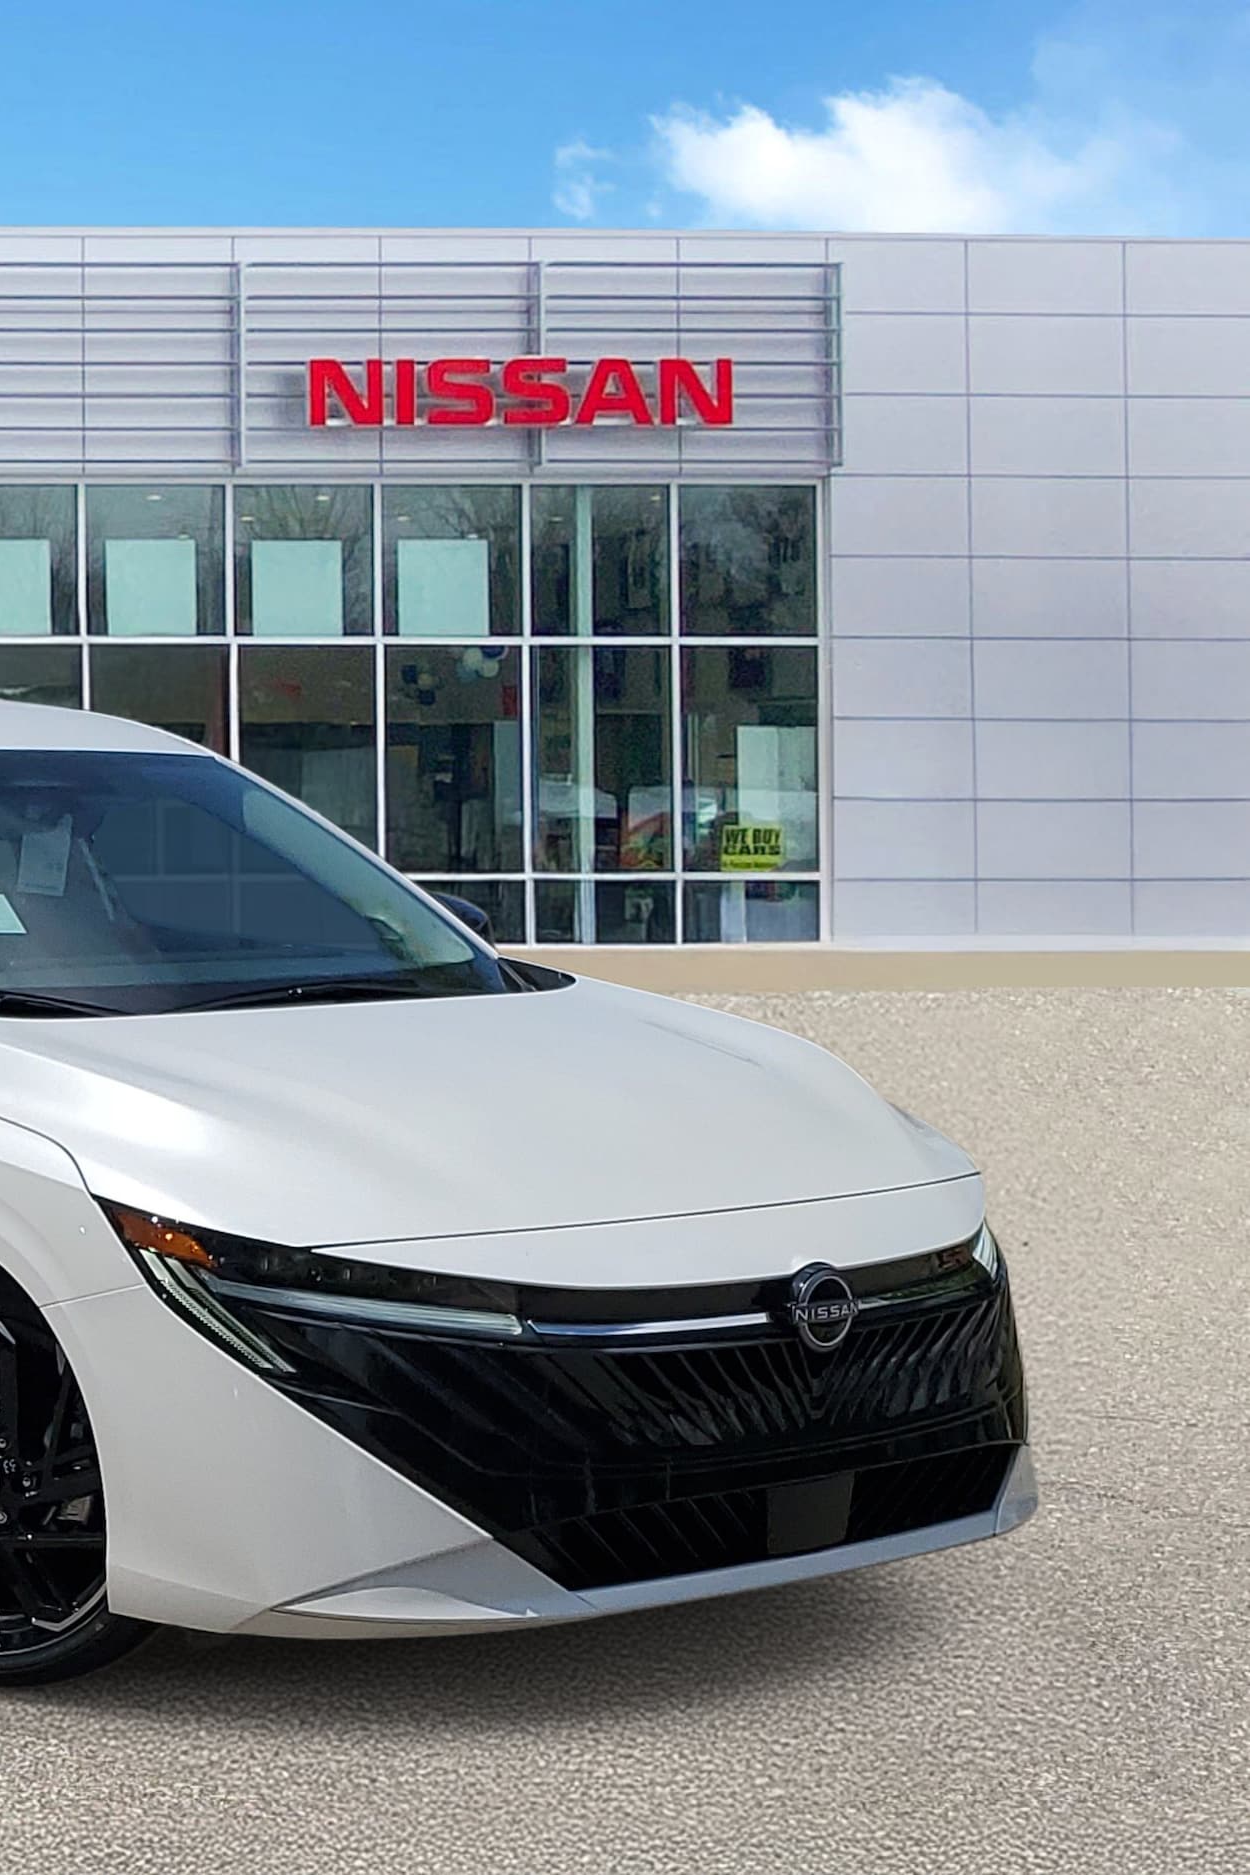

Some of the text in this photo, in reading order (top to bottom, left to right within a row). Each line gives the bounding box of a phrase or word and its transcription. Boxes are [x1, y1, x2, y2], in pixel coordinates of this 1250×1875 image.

[309, 358, 734, 426] NISSAN
[724, 828, 781, 845] WE BUY
[723, 844, 781, 856] CARS
[795, 1300, 859, 1322] NISSAN
